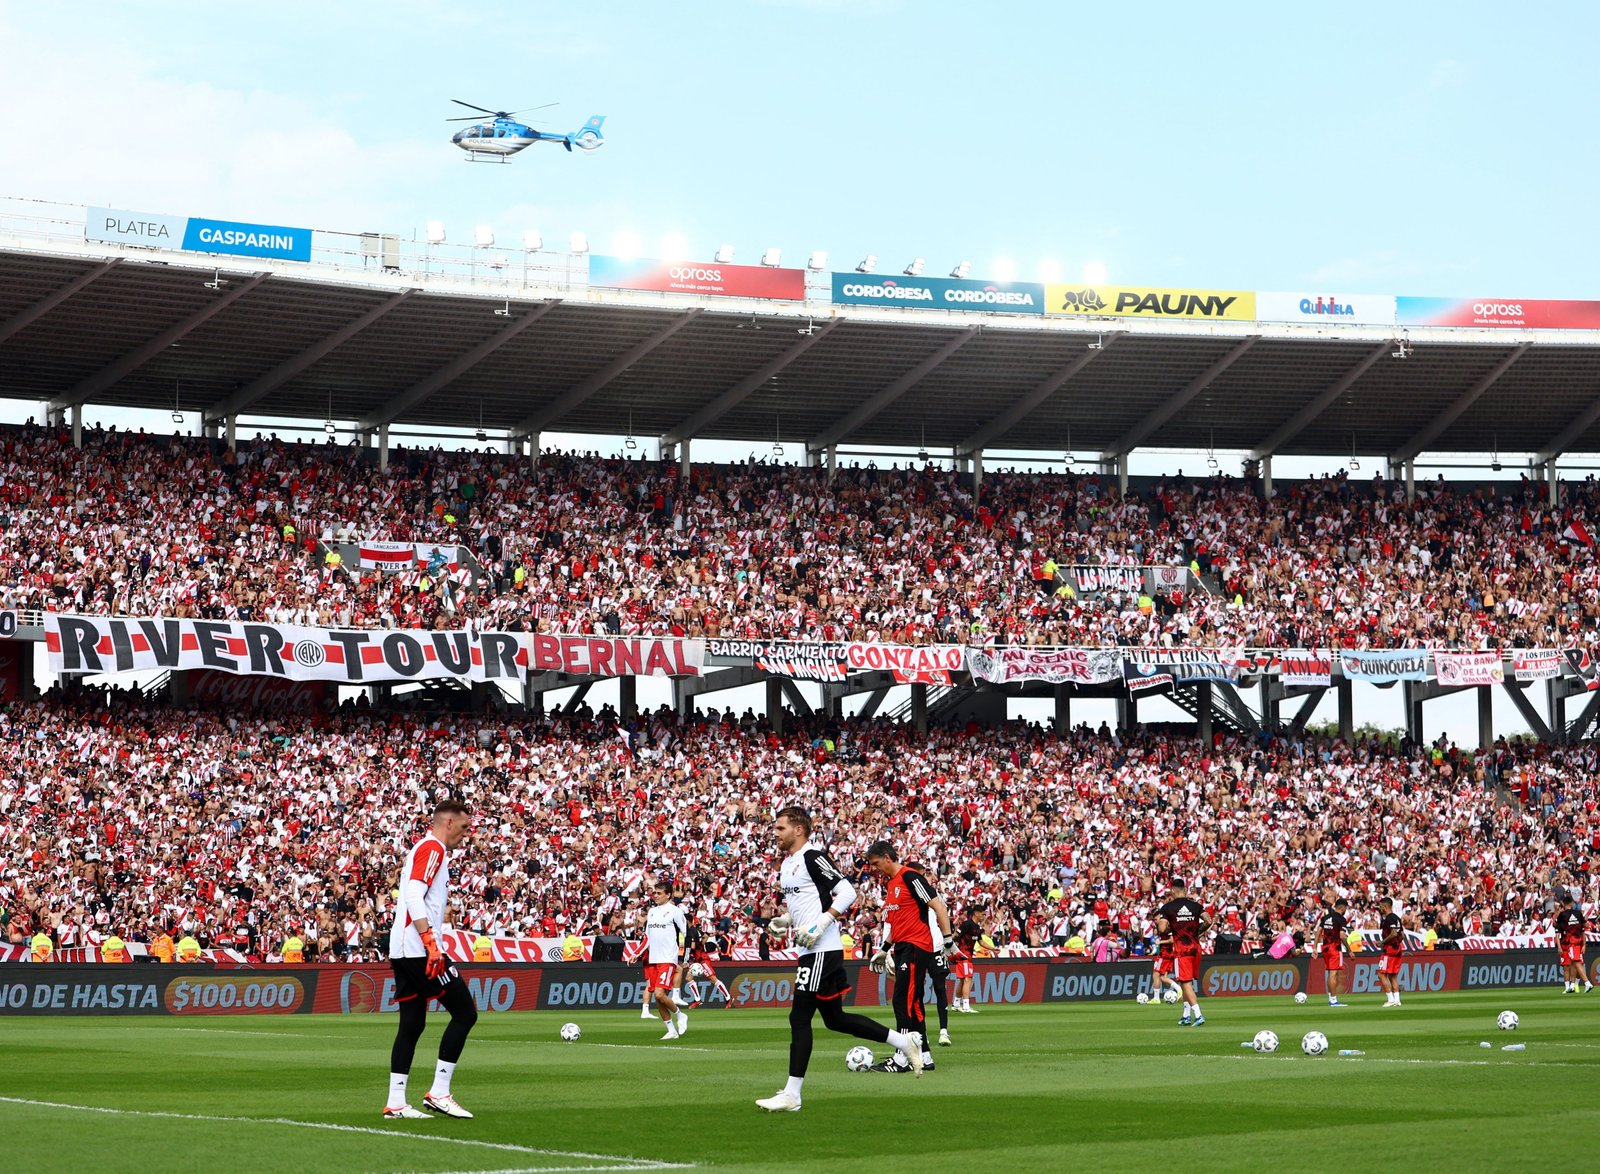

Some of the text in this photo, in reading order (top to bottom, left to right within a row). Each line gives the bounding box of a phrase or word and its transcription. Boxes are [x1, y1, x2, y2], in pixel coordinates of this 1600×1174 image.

[105, 217, 170, 238] PLATEA
[199, 227, 294, 251] GASPARINI
[1115, 290, 1238, 317] PAUNY
[1076, 568, 1098, 592] LAS
[56, 616, 519, 680] RIVER TOUR
[533, 633, 697, 678] BERNAL
[710, 641, 847, 660] BARRIO SARMIENTO
[848, 644, 962, 670] GONZALO
[1129, 649, 1221, 664] VILLA ROSA
[1525, 650, 1558, 660] LOS PIBES
[760, 657, 846, 682] SAN MIGUEL
[1285, 656, 1312, 677] KM
[1360, 656, 1425, 676] QUINQUELA
[1459, 656, 1472, 667] LA
[1478, 667, 1488, 676] LA
[1052, 975, 1102, 997] BONO
[1105, 974, 1134, 996] DE
[1208, 967, 1294, 995] $100.000
[1352, 961, 1446, 993] BEANO
[1467, 965, 1500, 985] BONO
[1514, 964, 1535, 983] DE
[32, 984, 71, 1009] DE
[72, 984, 158, 1009] HASTA
[174, 980, 296, 1011] $100.000
[547, 981, 614, 1006] BONO
